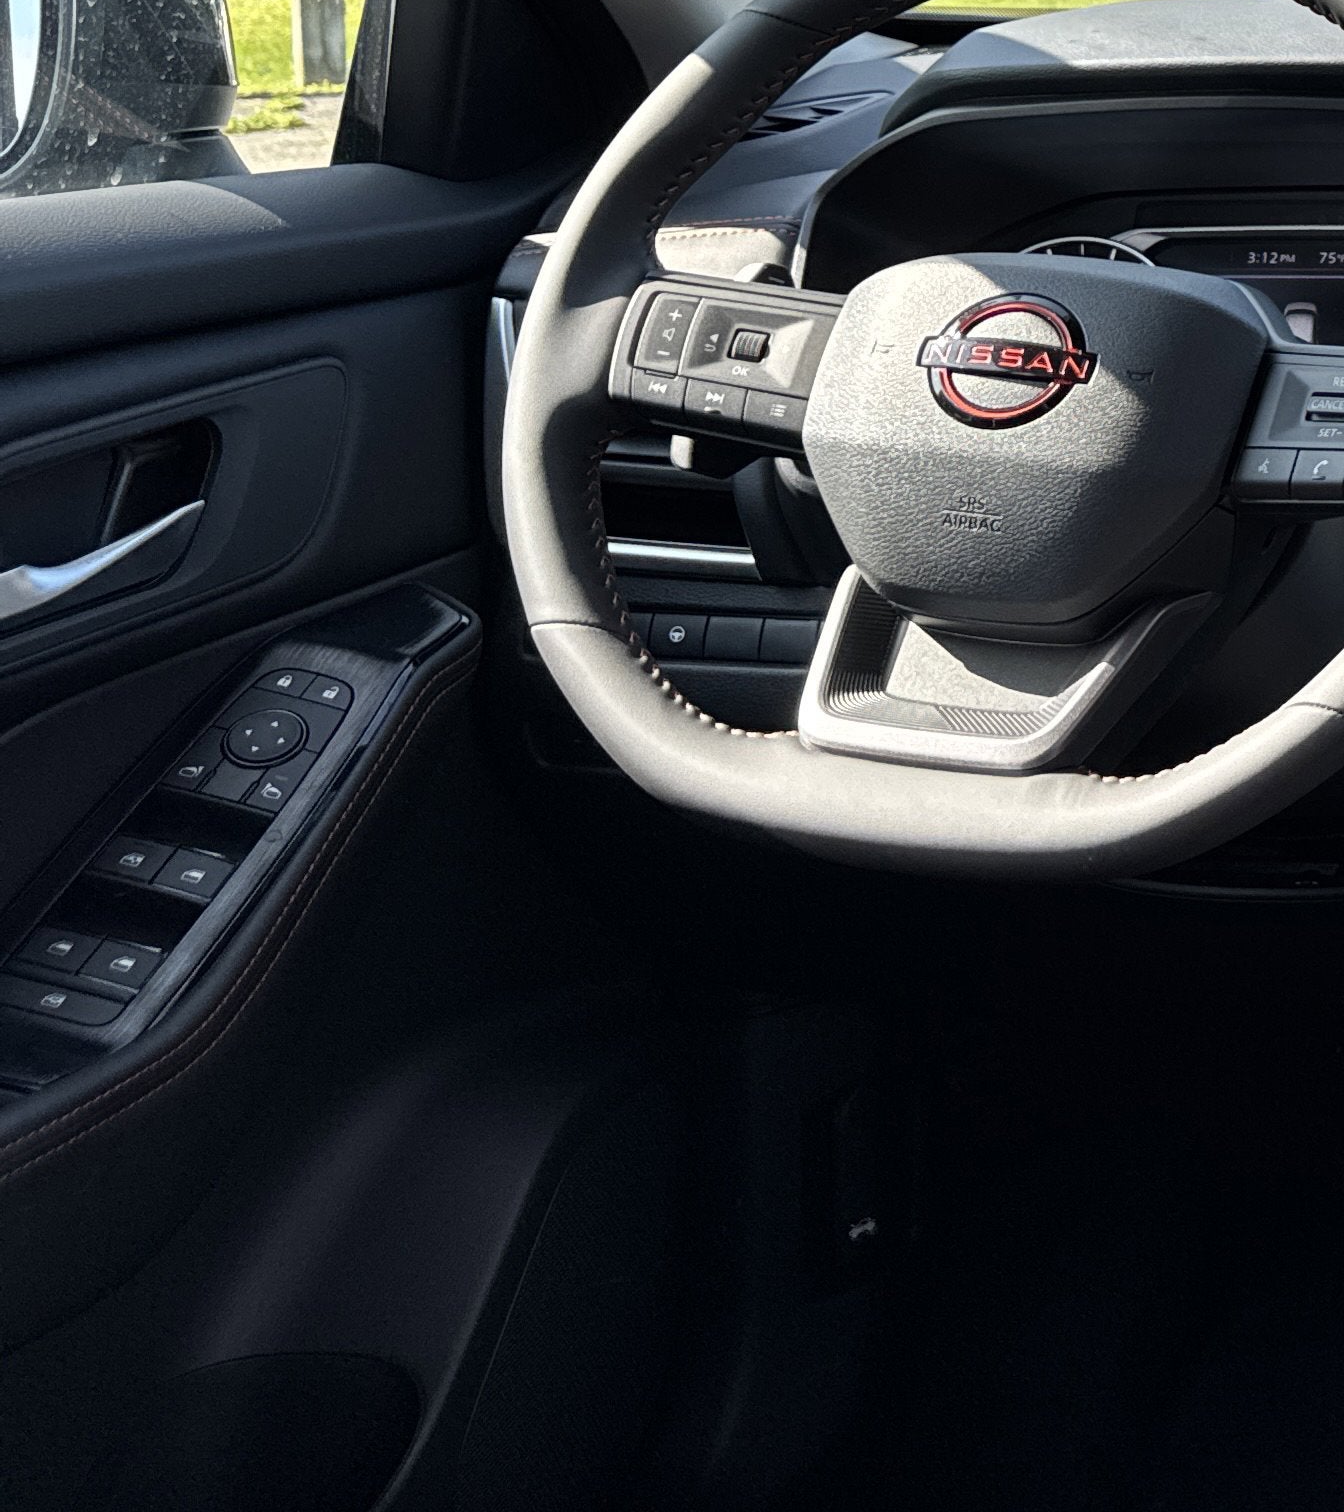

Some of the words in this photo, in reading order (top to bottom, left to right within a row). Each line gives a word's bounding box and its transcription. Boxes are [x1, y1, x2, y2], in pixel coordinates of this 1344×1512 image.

[924, 342, 1090, 380] NISSAN
[731, 365, 750, 377] OK
[958, 495, 987, 512] SRS
[941, 513, 1003, 533] AIRBAG
